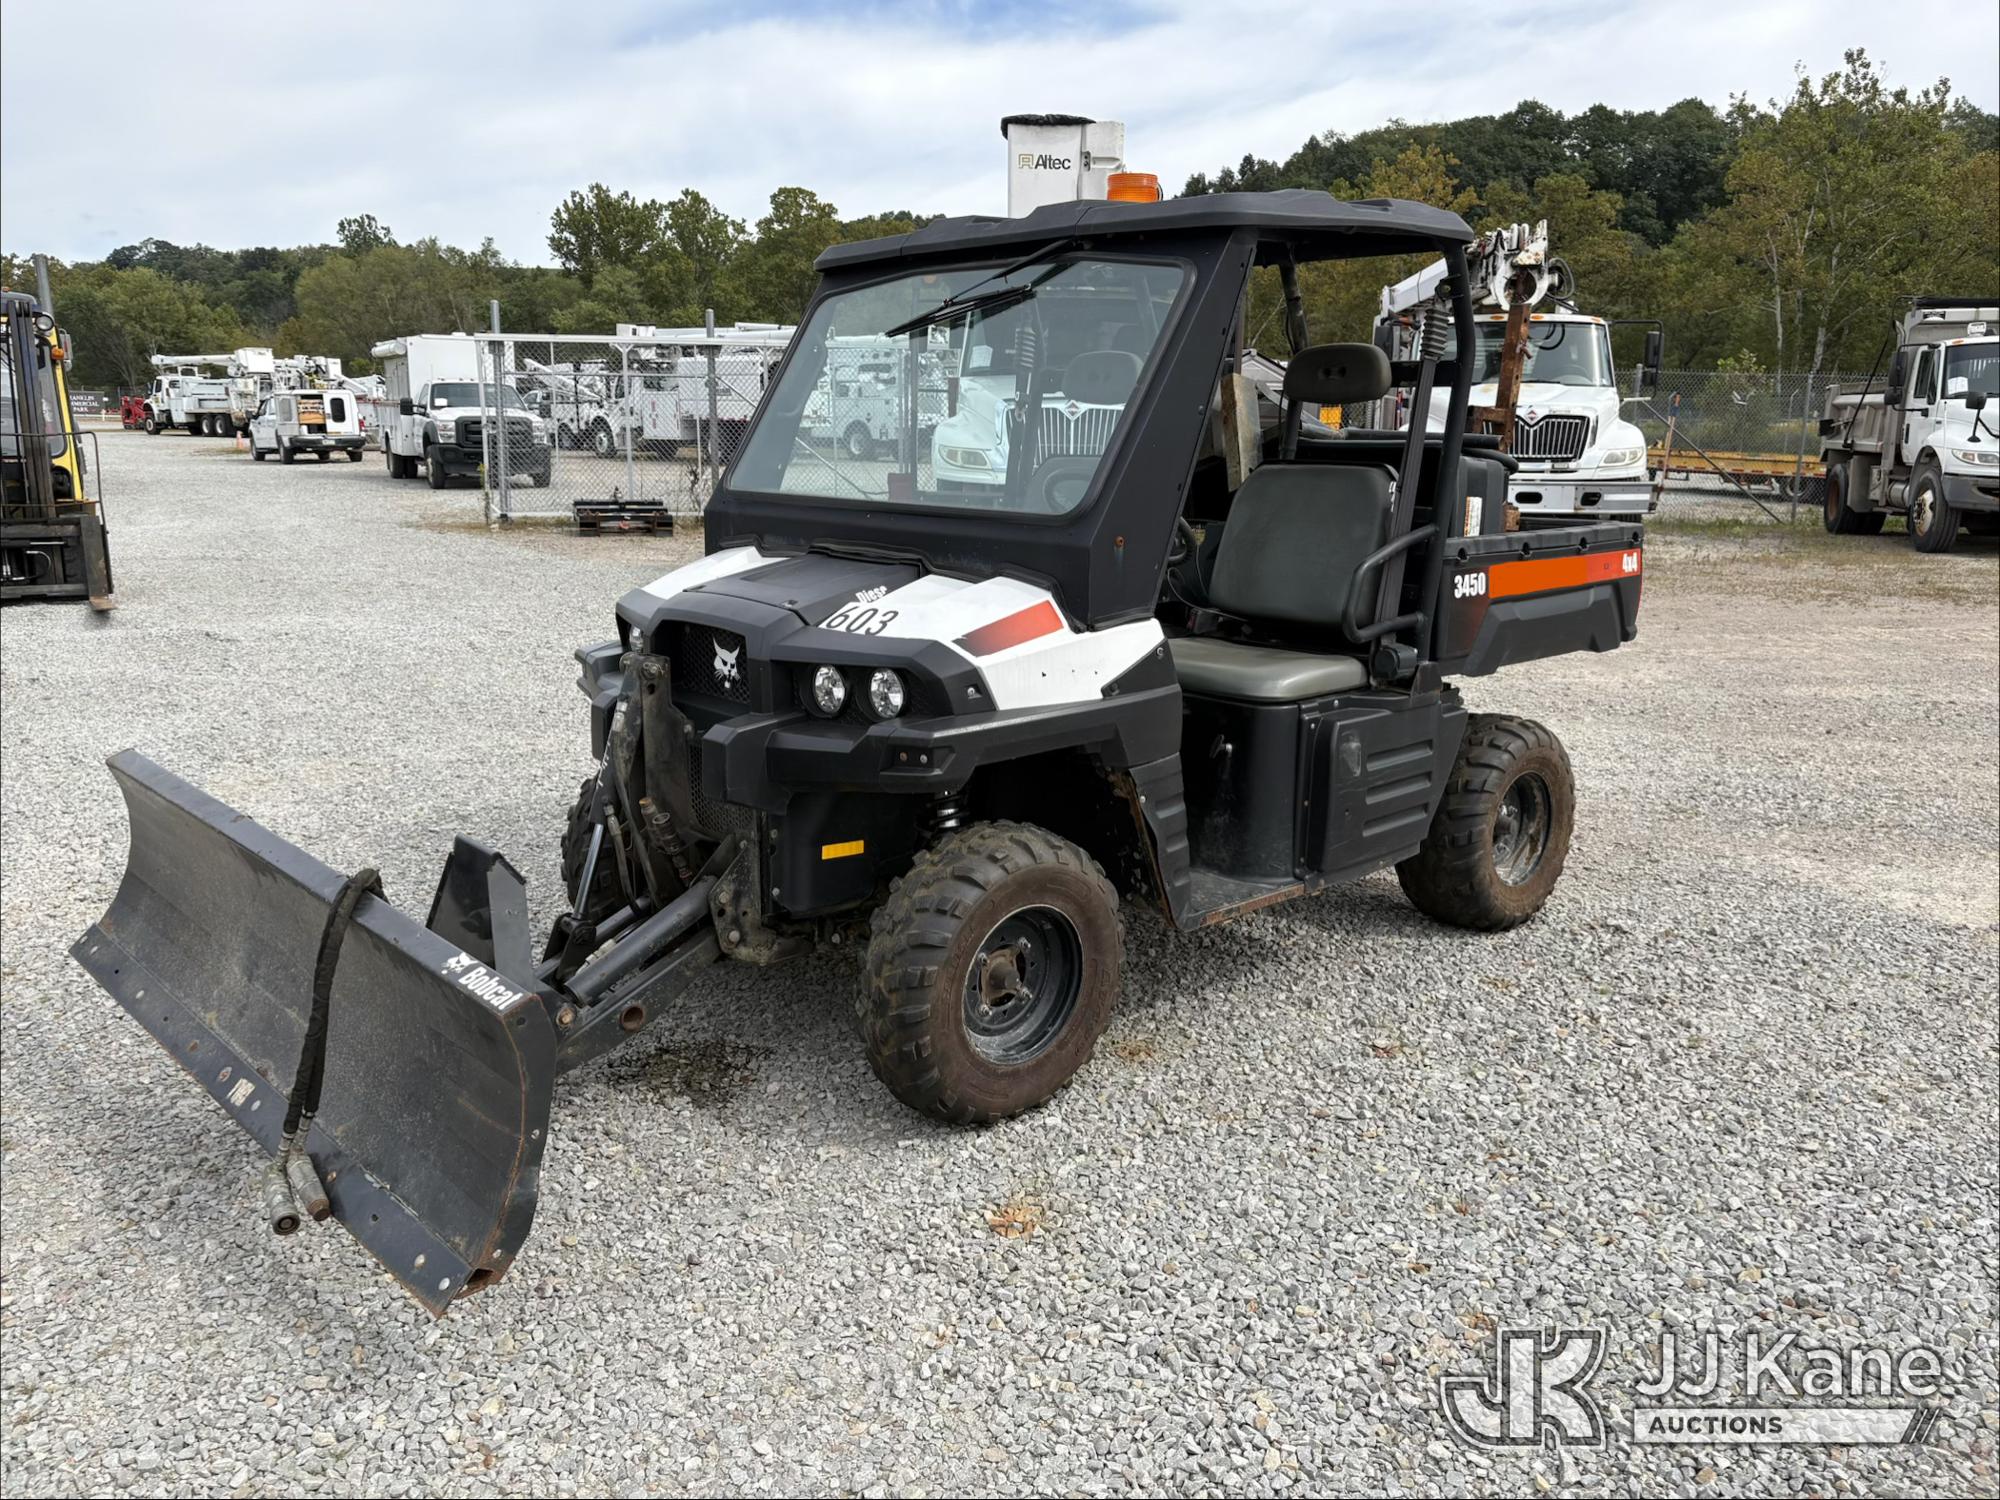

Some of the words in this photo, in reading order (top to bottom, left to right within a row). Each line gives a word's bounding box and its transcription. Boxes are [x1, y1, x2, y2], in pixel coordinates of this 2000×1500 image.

[1034, 154, 1071, 170] Altec
[1622, 552, 1638, 573] 4x4
[1454, 572, 1486, 599] 3450
[826, 605, 899, 636] 603
[458, 966, 524, 1010] Bobcat
